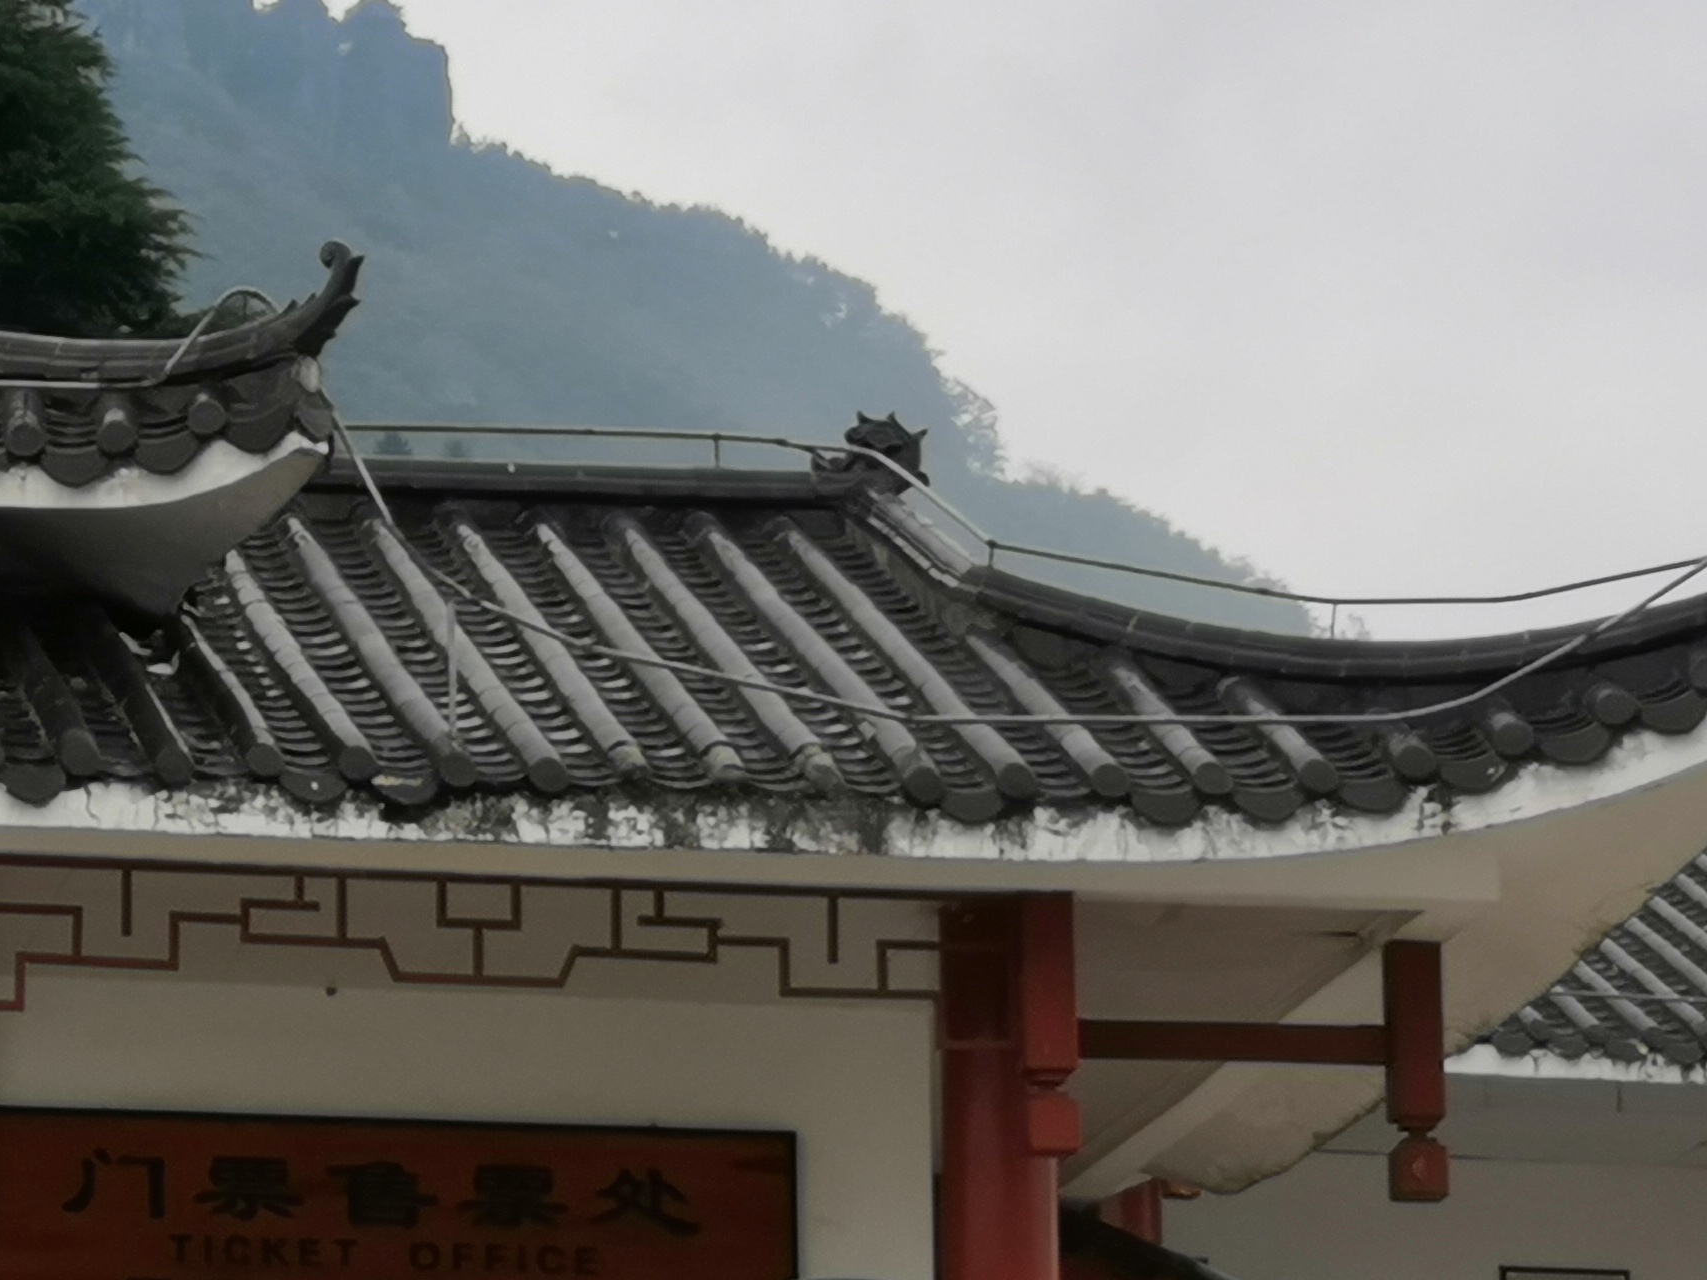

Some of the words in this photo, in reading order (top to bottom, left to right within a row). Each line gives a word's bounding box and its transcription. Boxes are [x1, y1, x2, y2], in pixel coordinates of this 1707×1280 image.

[60, 1146, 702, 1237] 门票售票处
[168, 1232, 360, 1269] TICKET
[409, 1239, 601, 1277] OFFICE
